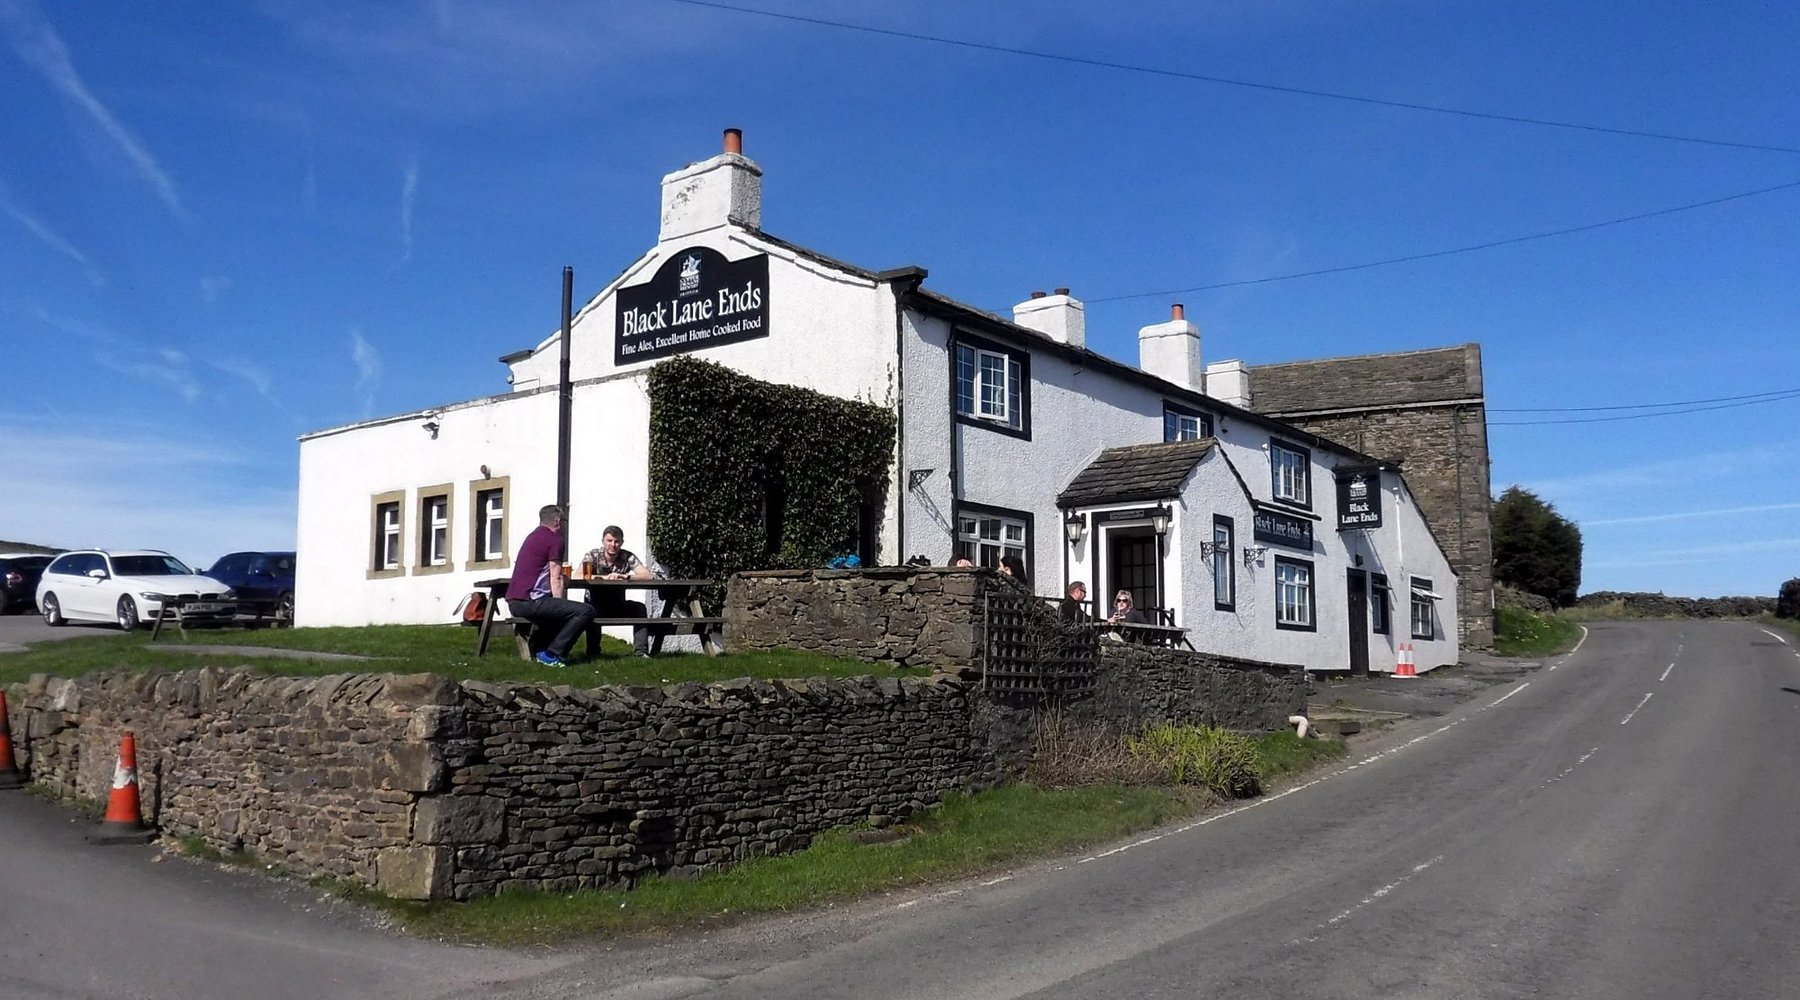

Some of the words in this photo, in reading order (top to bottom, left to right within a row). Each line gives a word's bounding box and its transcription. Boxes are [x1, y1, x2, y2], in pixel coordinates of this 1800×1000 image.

[622, 302, 667, 336] Black
[672, 298, 713, 326] Lane
[718, 280, 761, 316] Ends
[622, 344, 637, 355] Fine
[638, 340, 654, 351] Ales,
[656, 332, 687, 348] Excellent
[689, 329, 711, 341] Home
[712, 320, 740, 336] Cooked
[742, 315, 761, 330] Food
[1341, 514, 1359, 523] Lane
[1360, 512, 1378, 521] Ends
[1349, 502, 1369, 512] Black
